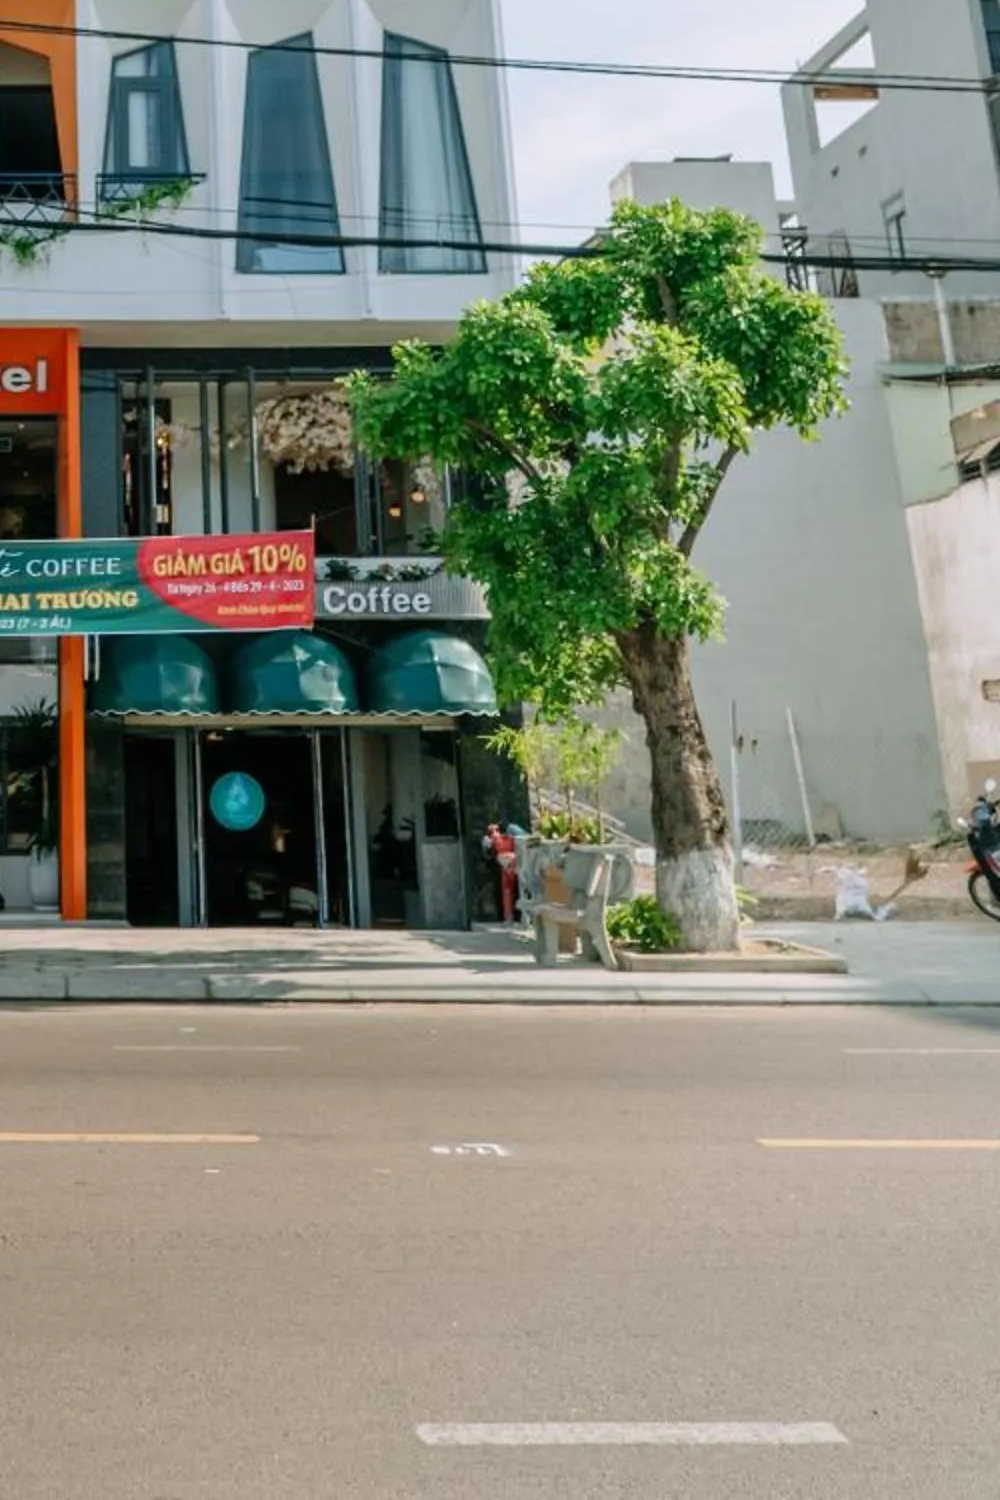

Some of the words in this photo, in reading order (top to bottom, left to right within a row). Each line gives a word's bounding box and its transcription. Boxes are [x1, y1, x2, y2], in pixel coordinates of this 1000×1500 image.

[26, 557, 121, 577] COFFEE
[153, 550, 207, 577] GIẢM
[211, 549, 245, 575] GIÁ
[248, 544, 306, 573] 10%
[36, 590, 139, 609] TRƯƠNG
[323, 586, 431, 614] Coffee
